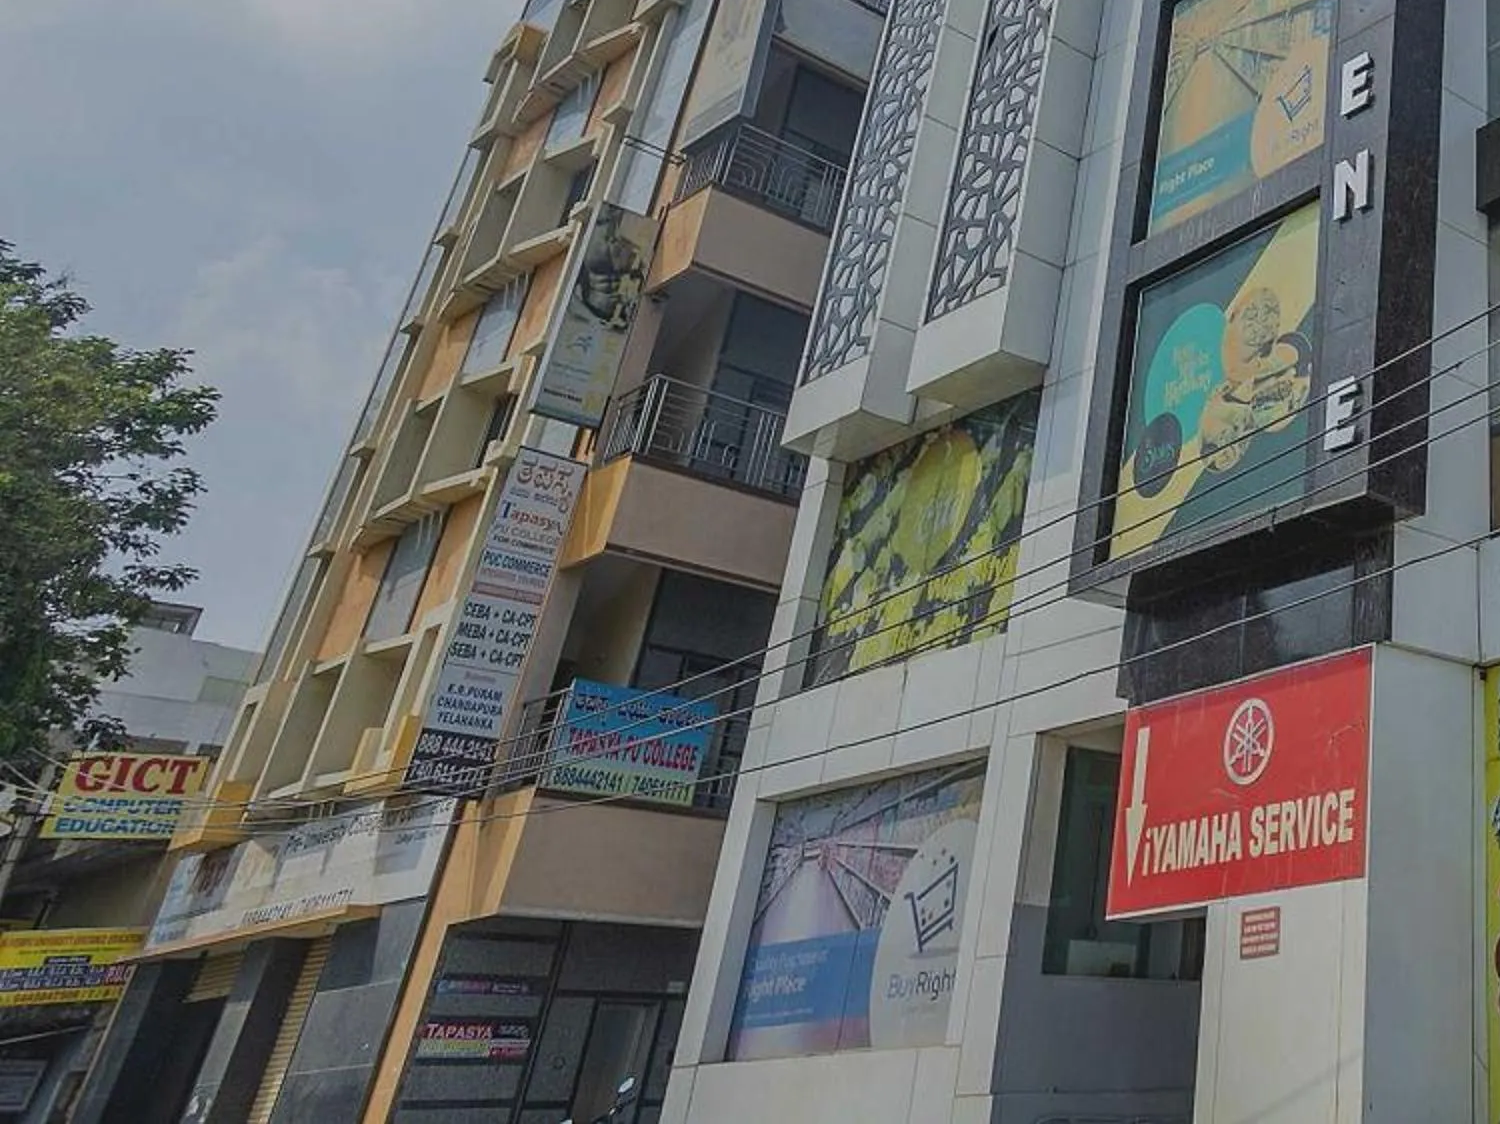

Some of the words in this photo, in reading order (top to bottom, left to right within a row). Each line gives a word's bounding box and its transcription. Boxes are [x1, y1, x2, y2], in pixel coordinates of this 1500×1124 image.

[642, 738, 699, 772] COLLEGE
[75, 756, 201, 794] GICT
[63, 796, 184, 815] COMPUTER
[54, 816, 175, 834] EDUCATION
[1249, 788, 1355, 859] SERVICE
[425, 1022, 493, 1040] TAPASYA
